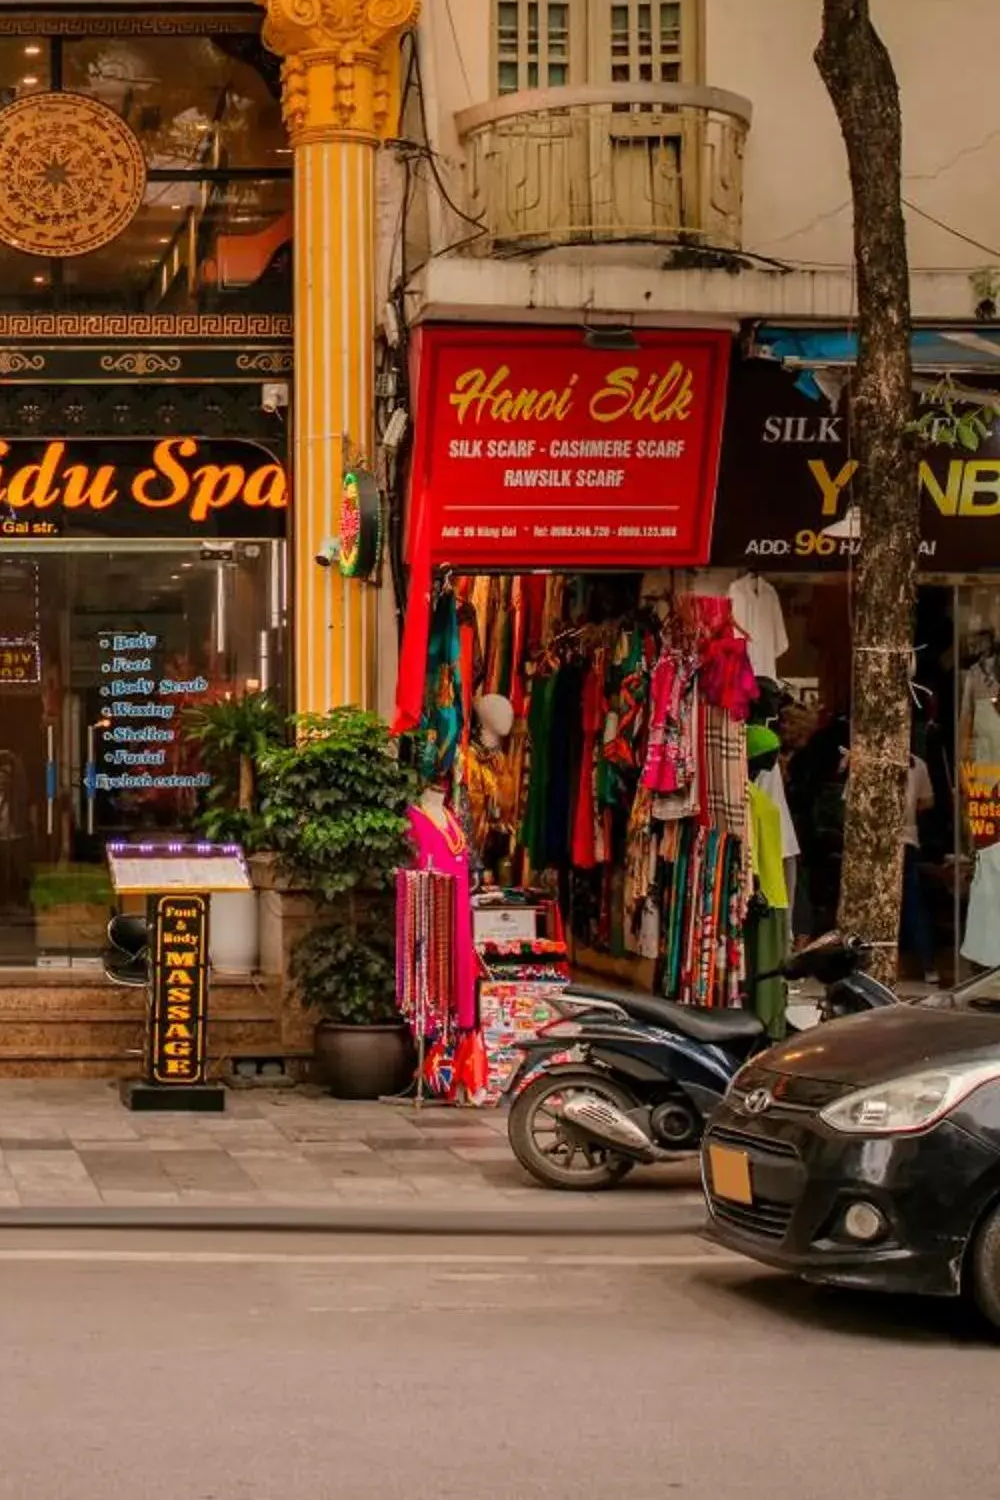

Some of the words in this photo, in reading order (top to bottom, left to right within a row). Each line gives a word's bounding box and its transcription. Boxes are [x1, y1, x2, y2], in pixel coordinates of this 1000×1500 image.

[449, 365, 579, 425] Hanoi
[588, 360, 693, 423] Silk
[762, 416, 845, 443] SILK
[448, 439, 483, 458] SILK
[487, 439, 536, 458] SCARF
[550, 439, 631, 459] CASHMERE
[636, 440, 685, 459] SCARF
[131, 436, 289, 522] Spa
[504, 469, 571, 487] RAWSILK
[576, 469, 625, 487] SCARF
[32, 521, 58, 534] str.
[744, 539, 791, 556] ADD:
[794, 529, 836, 556] 96
[175, 920, 187, 932] &
[163, 951, 196, 1074] MASSAGE
